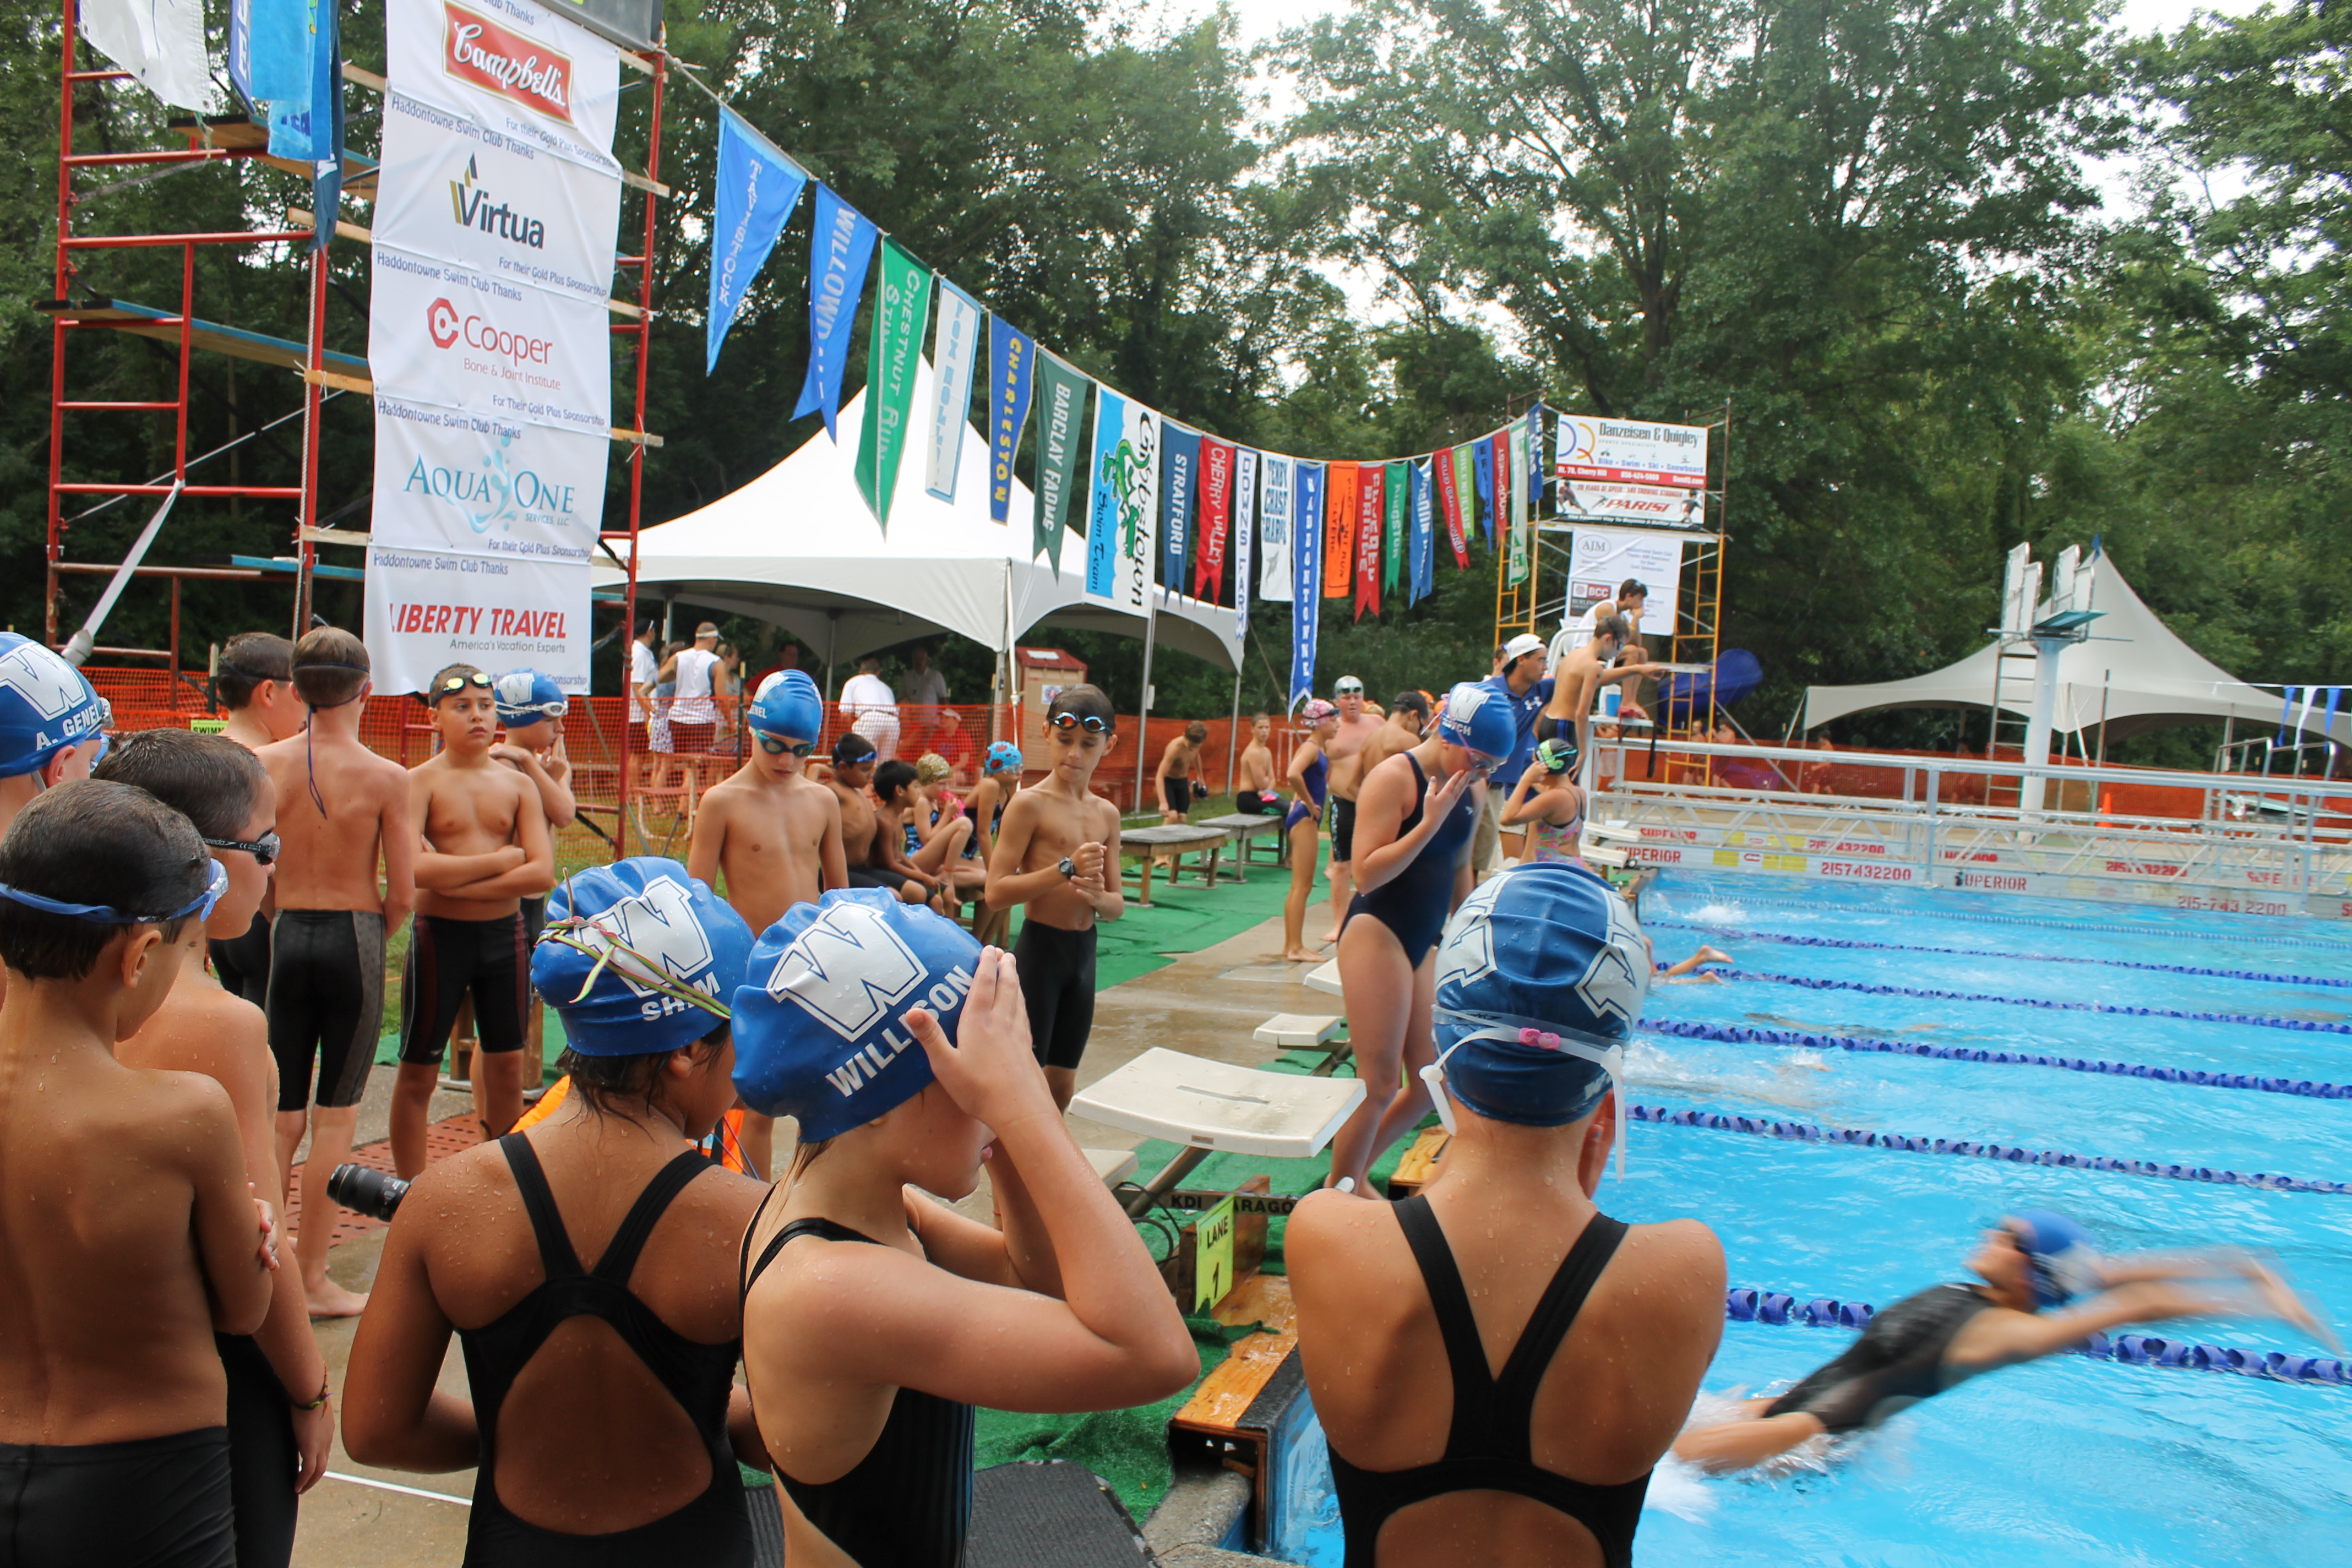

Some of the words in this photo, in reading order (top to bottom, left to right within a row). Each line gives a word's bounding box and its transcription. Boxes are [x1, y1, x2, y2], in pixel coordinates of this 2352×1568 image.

[505, 1, 535, 25] Thanks
[454, 21, 566, 106] Campbell's
[391, 95, 454, 130] Haddontowne
[456, 120, 480, 140] Swim
[482, 129, 503, 148] Club
[505, 138, 534, 160] Thanks
[506, 117, 516, 130] For
[520, 123, 538, 138] their
[457, 181, 546, 249] Virtua
[377, 251, 441, 280] Haddontowne
[444, 268, 468, 286] Swim
[471, 274, 490, 292] Club
[492, 281, 522, 301] Thanks
[498, 256, 512, 270] For
[513, 260, 531, 275] their
[532, 266, 549, 280] Gold
[549, 270, 565, 285] Plus
[566, 276, 607, 297] Sponsorship
[464, 315, 553, 367] Cooper
[464, 358, 488, 374] Bone
[491, 365, 498, 377] &
[500, 366, 524, 383] Joint
[525, 371, 561, 391] Institute
[378, 401, 441, 426] Haddontowne
[443, 416, 468, 431] Swim
[471, 418, 490, 434] Club
[492, 423, 521, 440] Thanks
[493, 394, 505, 406] For
[507, 397, 527, 411] Their
[529, 402, 544, 415] Gold
[546, 406, 562, 420] Plus
[563, 410, 605, 427] Sponsorship
[994, 337, 1022, 502] CHARLESTON
[1048, 382, 1071, 467] BARCLAY
[1599, 422, 1651, 440] Danzeisen
[1654, 428, 1661, 440] &
[1664, 428, 1699, 448] Quigley
[1209, 447, 1227, 510] CHERRY
[1598, 457, 1613, 465] Bike
[1621, 459, 1640, 467] Swim
[514, 470, 575, 514] ONE
[1170, 453, 1188, 556] STRATFORD
[1239, 458, 1252, 546] DOWNS
[1605, 499, 1673, 513] PARISI
[1095, 491, 1109, 537] Swim
[488, 538, 501, 550] For
[502, 540, 518, 552] their
[519, 543, 534, 555] Gold
[536, 544, 551, 556] Plus
[552, 546, 591, 558] Sponsorship
[1582, 541, 1606, 552] AJM
[434, 557, 458, 571] Swim
[461, 558, 478, 573] Club
[481, 559, 509, 575] Thanks
[1092, 542, 1105, 590] Team
[1588, 587, 1609, 597] BCC
[491, 608, 567, 639] TRAVEL
[449, 639, 495, 651] America's
[497, 640, 534, 652] Vacation
[537, 642, 566, 654] Experts
[36, 731, 58, 751] A.
[1615, 846, 1681, 863] UPERIOR
[1964, 873, 2027, 891] UPERIOR
[767, 900, 930, 1043] W
[1171, 1195, 1202, 1209] KDI
[1217, 1197, 1298, 1215] ARAGO
[1207, 1215, 1229, 1250] LANE
[1212, 1261, 1219, 1299] 1
